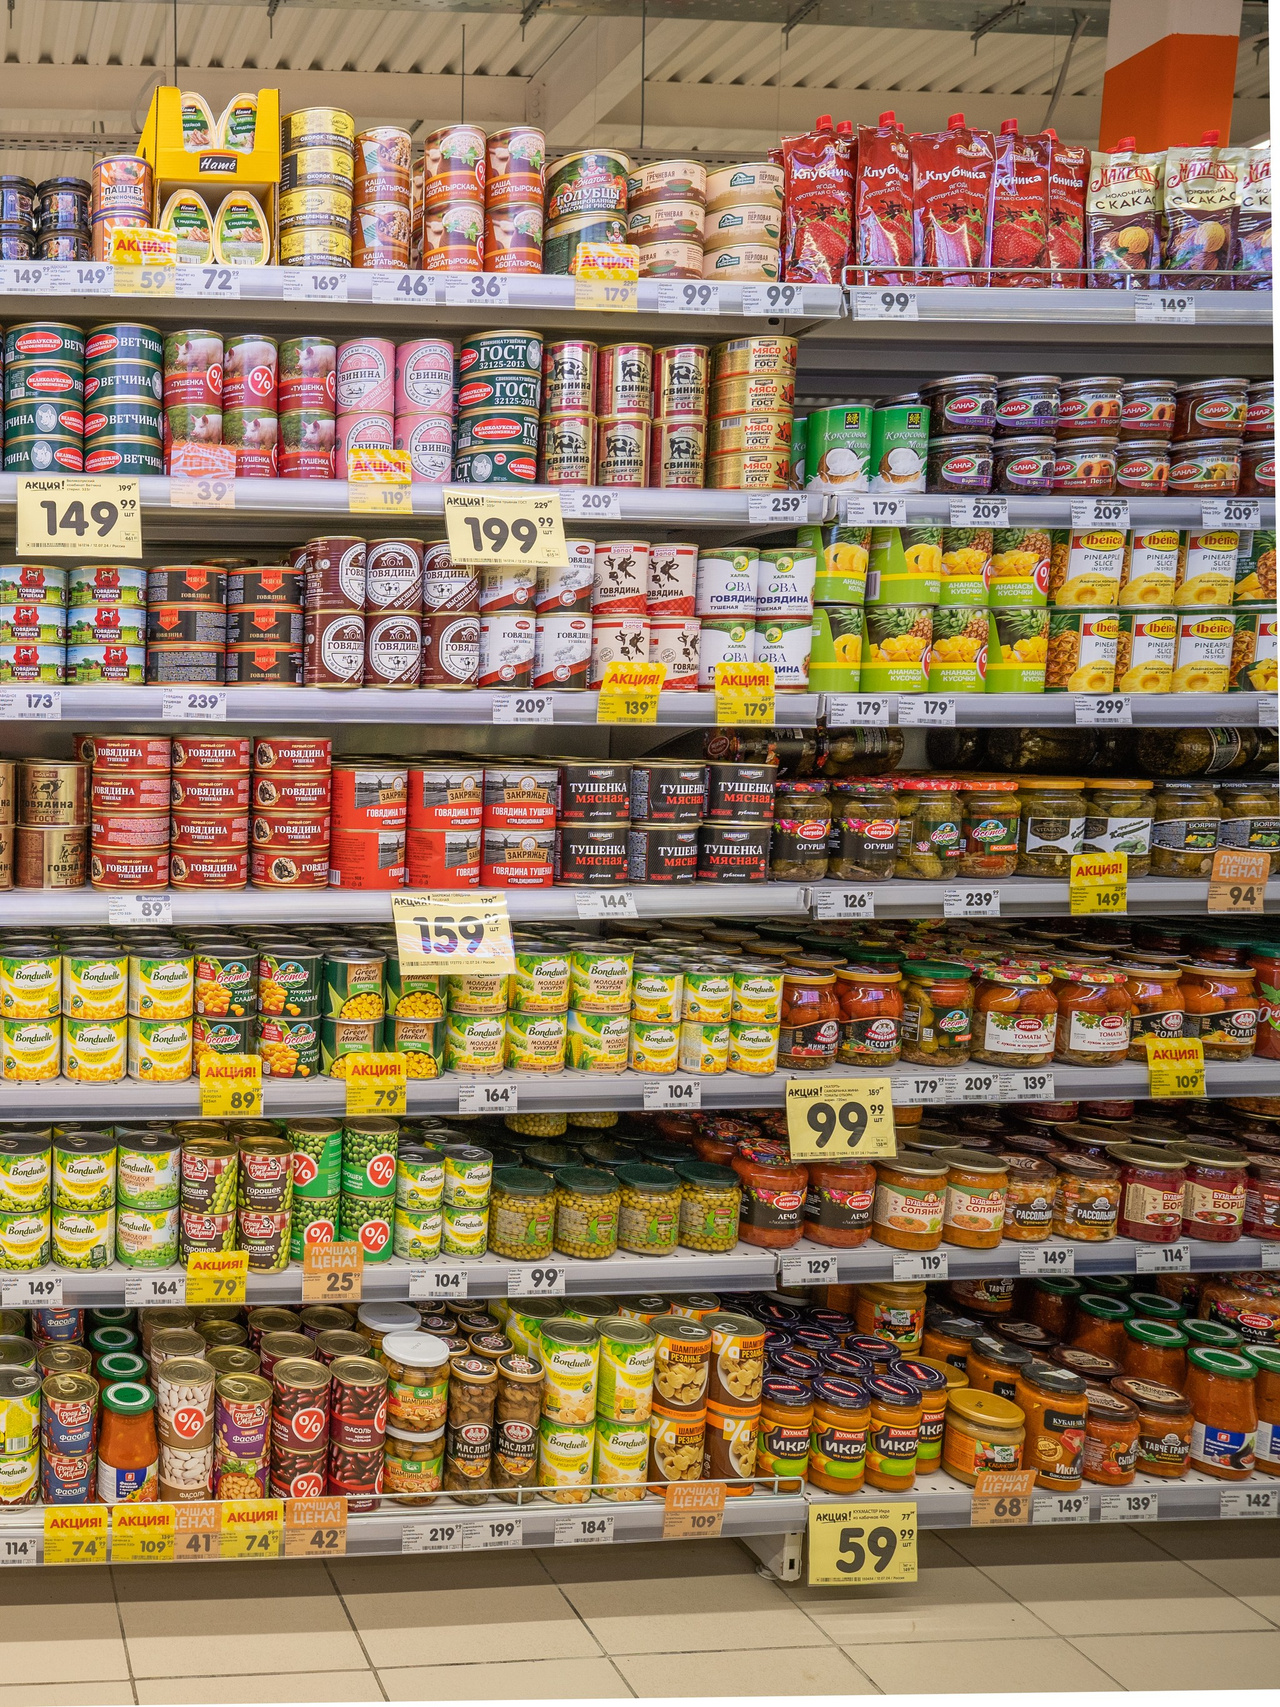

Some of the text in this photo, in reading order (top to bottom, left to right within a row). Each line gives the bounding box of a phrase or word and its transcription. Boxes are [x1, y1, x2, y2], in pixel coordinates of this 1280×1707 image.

[200, 156, 236, 171] Hamé
[926, 168, 986, 182] Клубника
[480, 346, 525, 362] ГОСТ
[480, 361, 524, 369] 32125-2013
[101, 376, 152, 387] ВЕТЧИНА
[823, 432, 867, 441] Кокосовое
[25, 481, 64, 490] АКЦИЯ!
[446, 497, 484, 508] АКЦИЯ!
[41, 499, 137, 536] 149 99
[464, 517, 554, 554] 199 99
[948, 581, 982, 590] АНАНАСЫ
[951, 588, 983, 596] КУСОЧКИ
[609, 672, 660, 685] АКЦИЯ!
[189, 748, 236, 758] ГОВЯДИНА
[570, 782, 627, 794] ТУШЕНКА
[505, 790, 548, 800] ЗАКРЯЖЬЕ
[492, 807, 553, 816] ГОВЯДИНА ТУШЕНАЯ
[1219, 856, 1264, 866] ЛУЧШАЯ
[1076, 864, 1122, 876] АКЦИЯ!
[1219, 865, 1263, 877] ЦЕНА!
[788, 1088, 823, 1099] АКЦИЯ!
[806, 1102, 884, 1148] 99 99
[901, 1207, 942, 1215] СОЛЯНКА
[552, 1357, 592, 1368] Bonduelle
[825, 1440, 866, 1455] ИКРА
[293, 1501, 341, 1512] ЛУЧШАЯ
[292, 1511, 341, 1524] ЦЕНА!
[50, 1518, 102, 1529] АКЦИЯ!
[836, 1527, 914, 1573] 59 99
